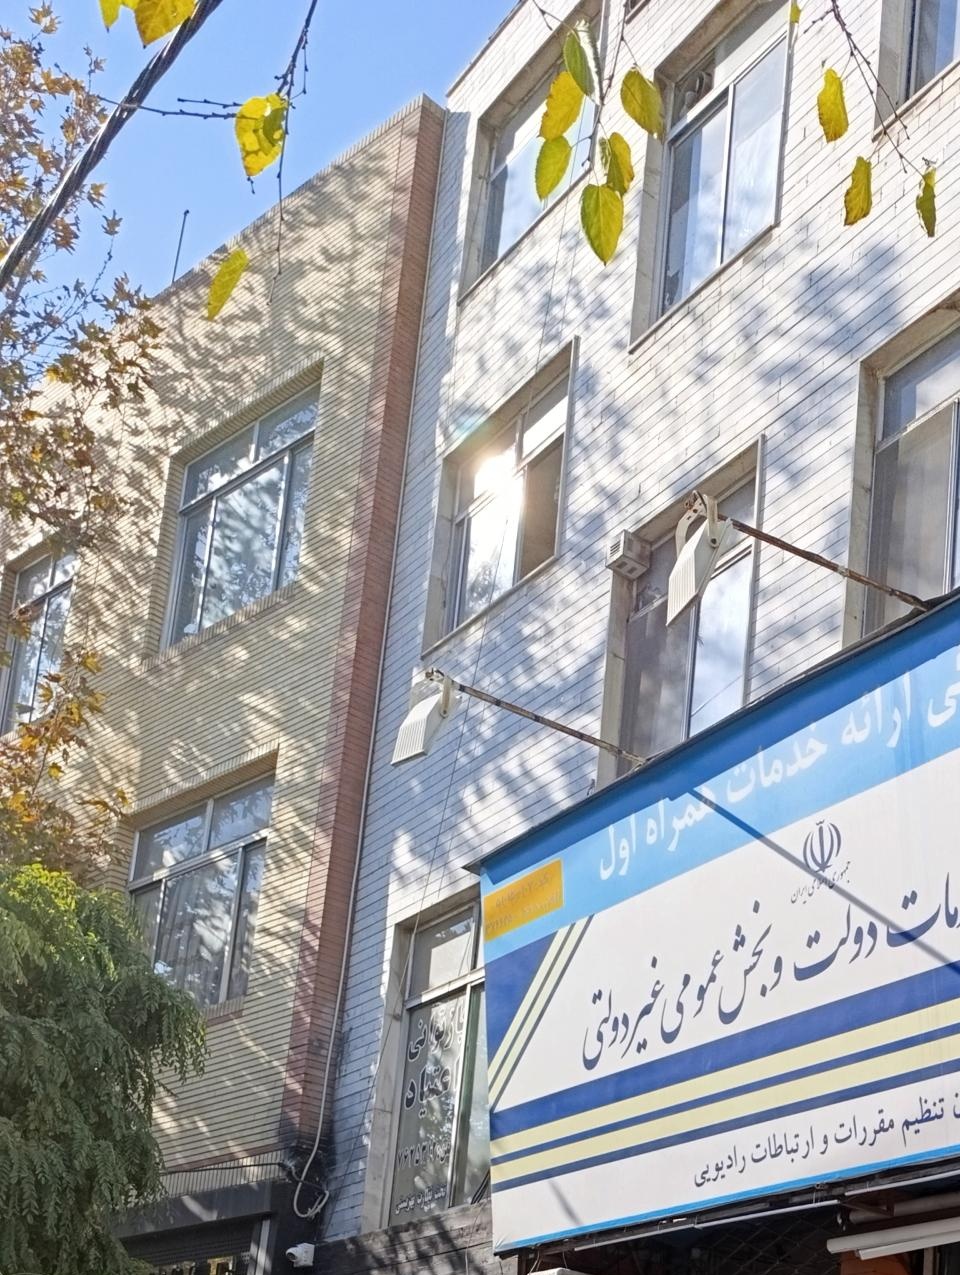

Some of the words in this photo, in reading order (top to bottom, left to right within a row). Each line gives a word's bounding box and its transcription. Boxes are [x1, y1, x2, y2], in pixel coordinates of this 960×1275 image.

[840, 671, 911, 748] ارائه
[726, 727, 828, 802] خدمات
[600, 812, 637, 881] اول
[645, 785, 717, 852] همراه
[718, 900, 773, 1025] بخش
[769, 955, 783, 991] و
[793, 904, 878, 981] دولت
[660, 949, 725, 1044] عمومی
[751, 1126, 814, 1163] ارتباطات
[820, 1135, 829, 1155] و
[834, 1108, 895, 1146] مقررات
[902, 1096, 945, 1146] تنظیم
[694, 1145, 746, 1187] رادیویی
